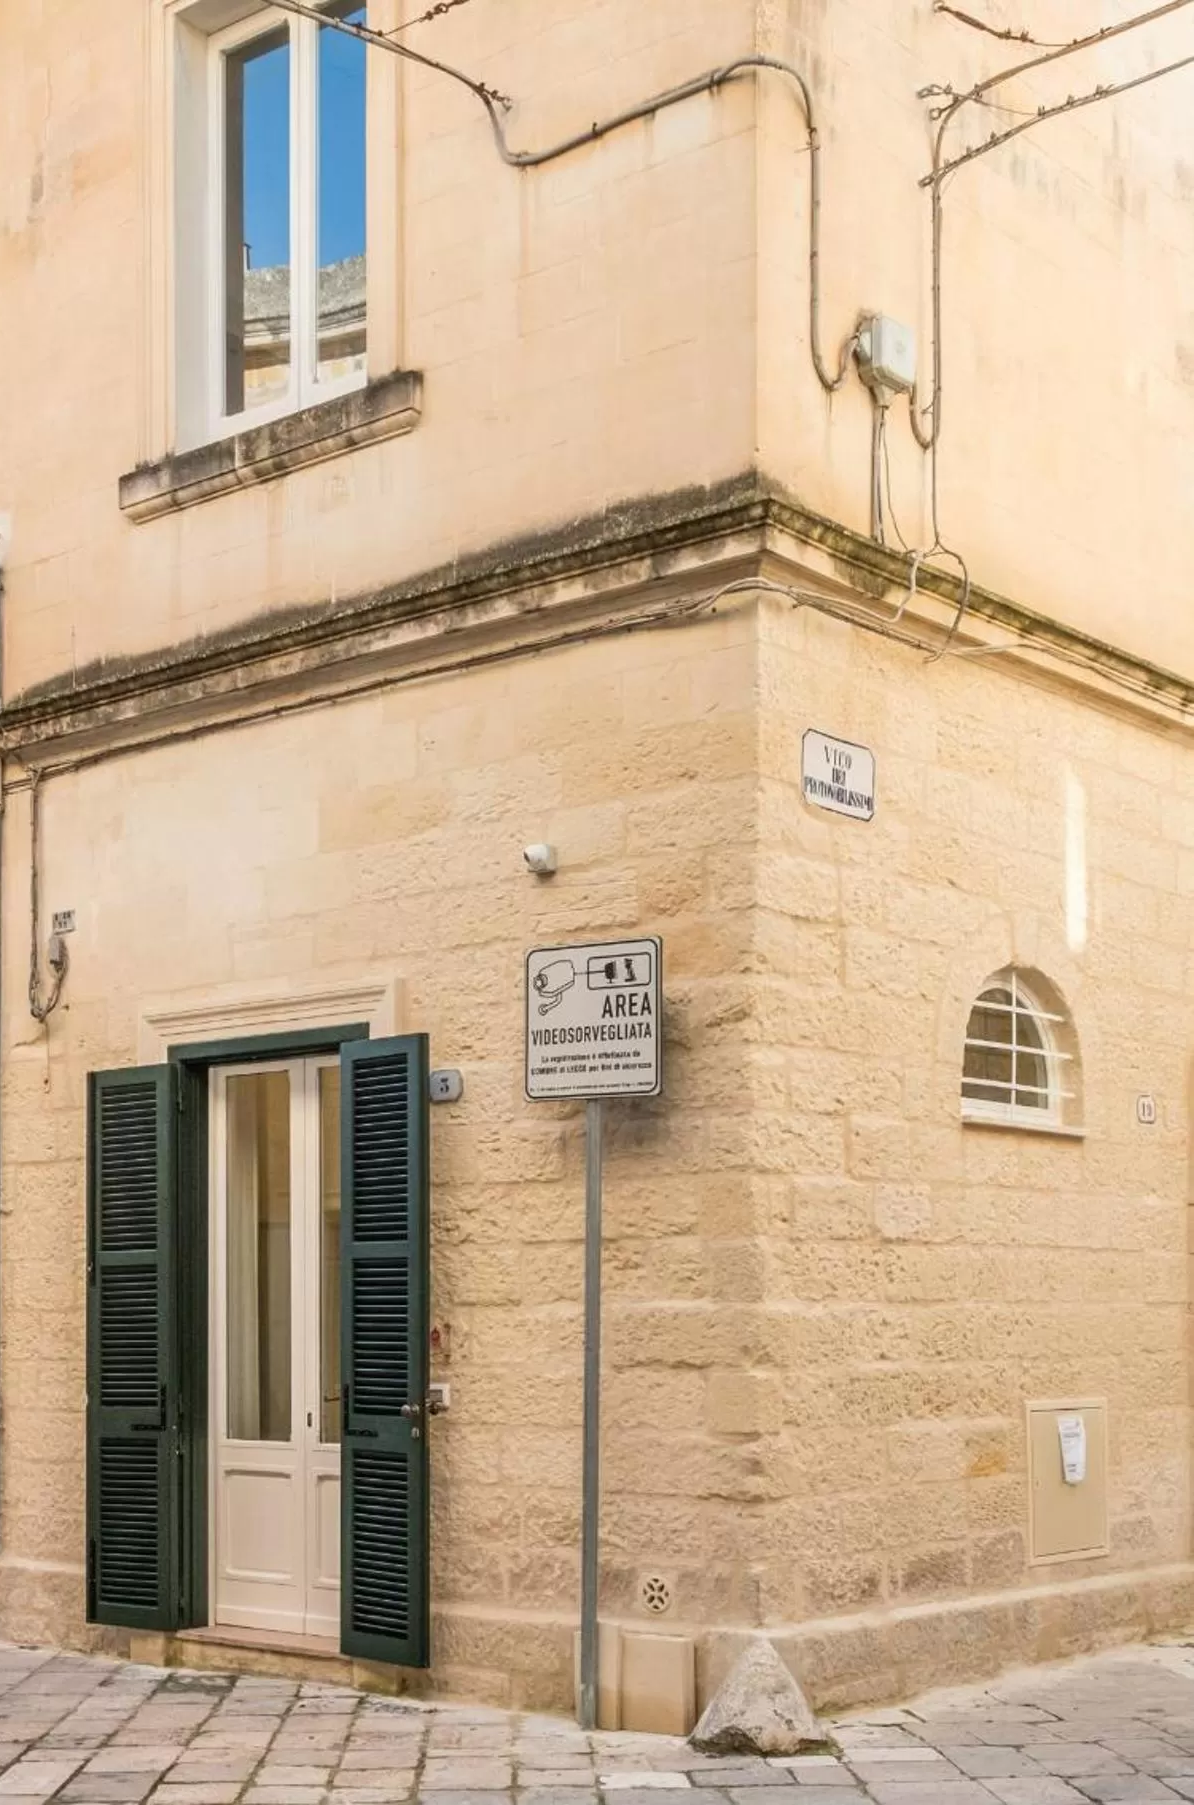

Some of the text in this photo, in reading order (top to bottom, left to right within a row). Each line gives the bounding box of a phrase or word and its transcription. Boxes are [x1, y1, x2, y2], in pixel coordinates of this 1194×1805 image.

[824, 745, 853, 770] VICO
[601, 991, 652, 1019] AREA
[531, 1022, 652, 1047] VIDEOSORVEGLIATA
